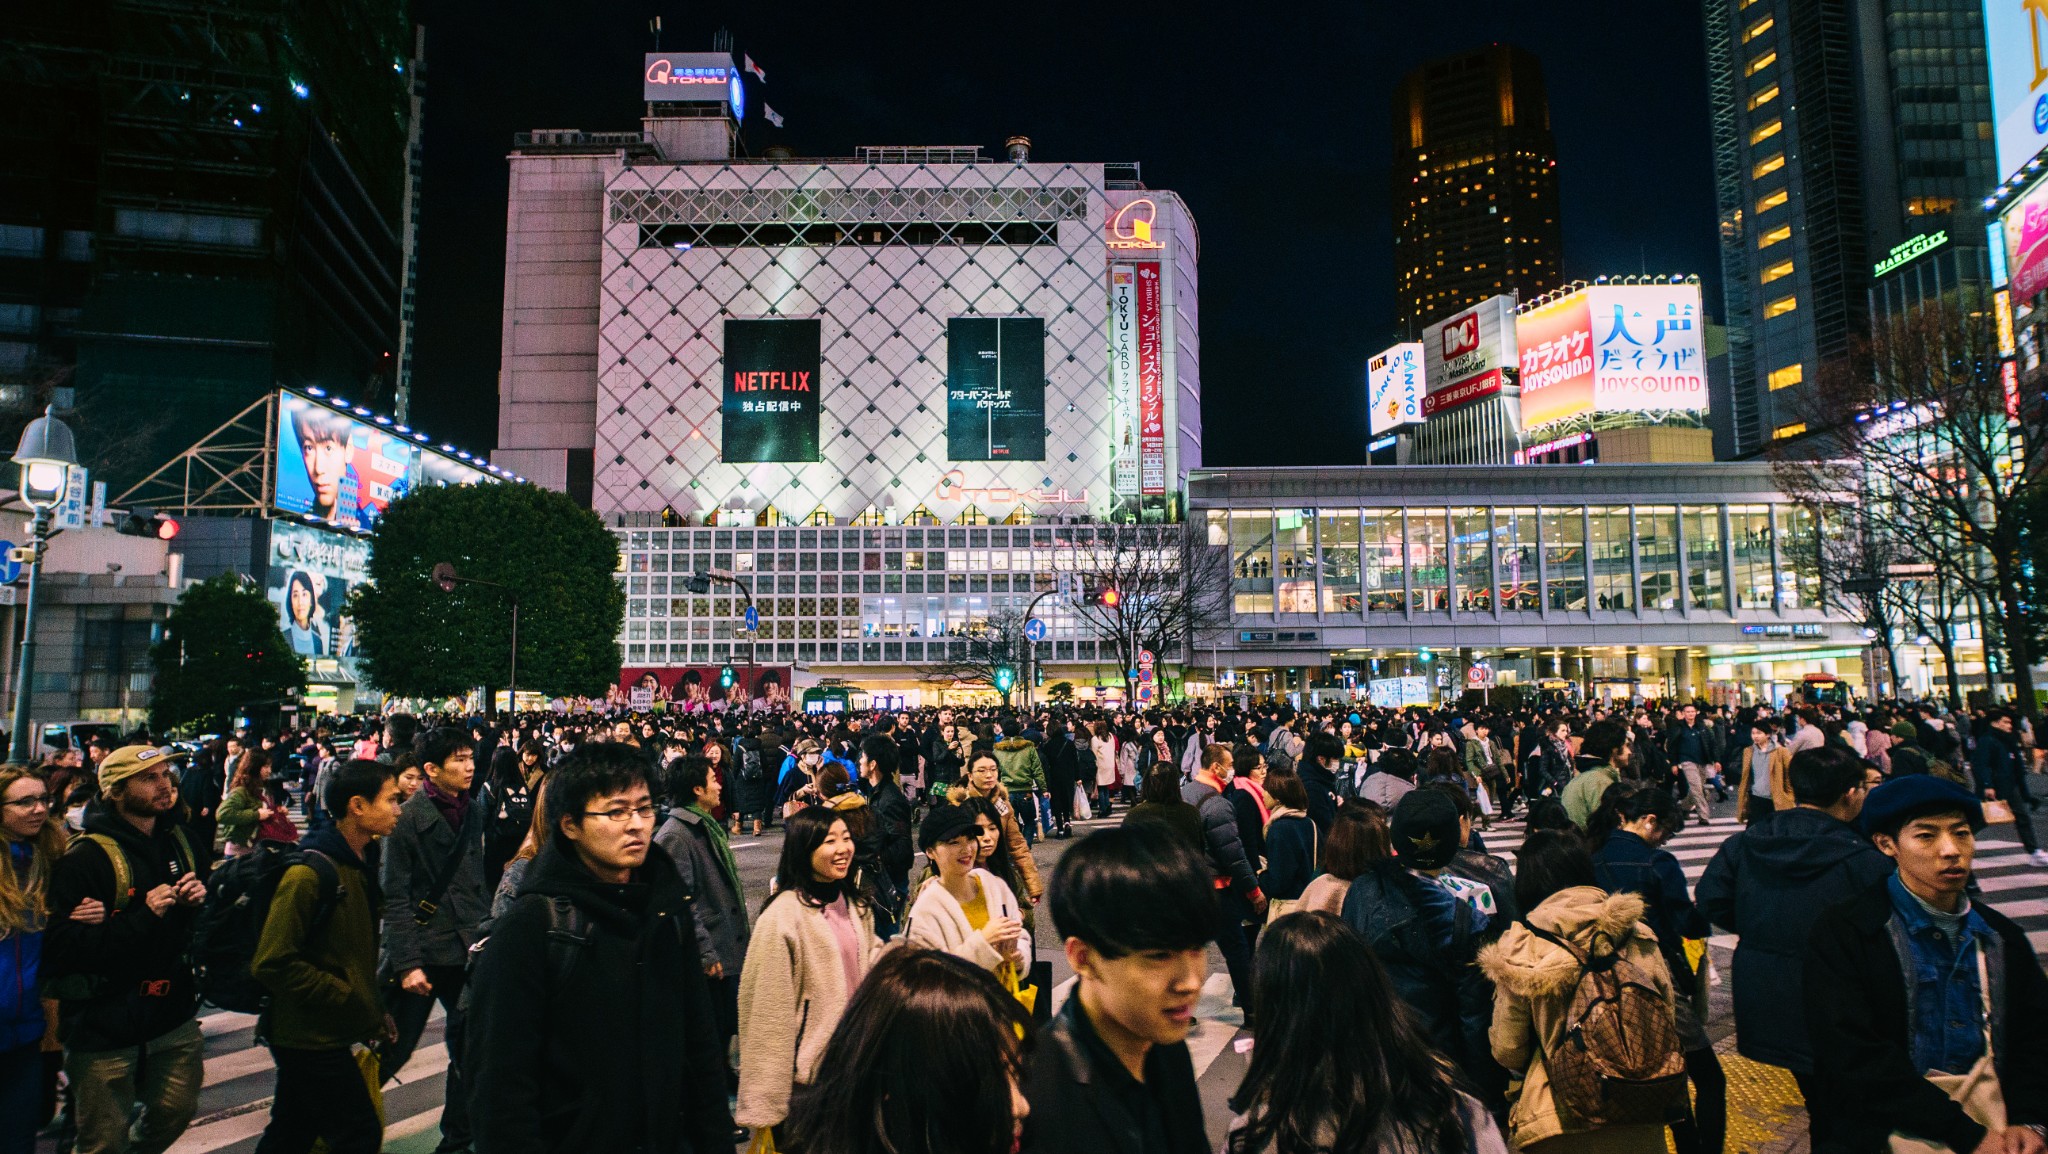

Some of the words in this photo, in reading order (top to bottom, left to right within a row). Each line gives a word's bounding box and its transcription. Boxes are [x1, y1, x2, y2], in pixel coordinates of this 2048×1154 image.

[669, 76, 727, 84] TOKYU
[1105, 241, 1166, 249] TOKYU
[1874, 248, 1911, 274] MARK
[1912, 230, 1946, 254] CITY
[1118, 286, 1129, 331] TOKYU
[1145, 279, 1153, 312] SHIBUYA
[1444, 318, 1475, 355] DC
[1598, 303, 1694, 347] 大声
[1120, 333, 1130, 370] CARD
[1454, 354, 1471, 368] VISA
[1522, 329, 1590, 376] カラオケ
[1598, 347, 1697, 371] だそうぜ
[735, 371, 811, 393] NETFLIX
[1371, 355, 1401, 411] SANKYO
[1403, 350, 1418, 416] SANKYO
[1448, 357, 1487, 380] MasterCard
[1523, 355, 1593, 394] JOYSOUND
[1141, 361, 1160, 423] スクランブル
[1439, 376, 1496, 405] 三菱東京UFJ銀行
[1600, 376, 1701, 393] JOYSOUND
[742, 400, 802, 412] 独占配信中
[976, 400, 1011, 408] パラドックス
[961, 487, 1090, 503] TOKYU
